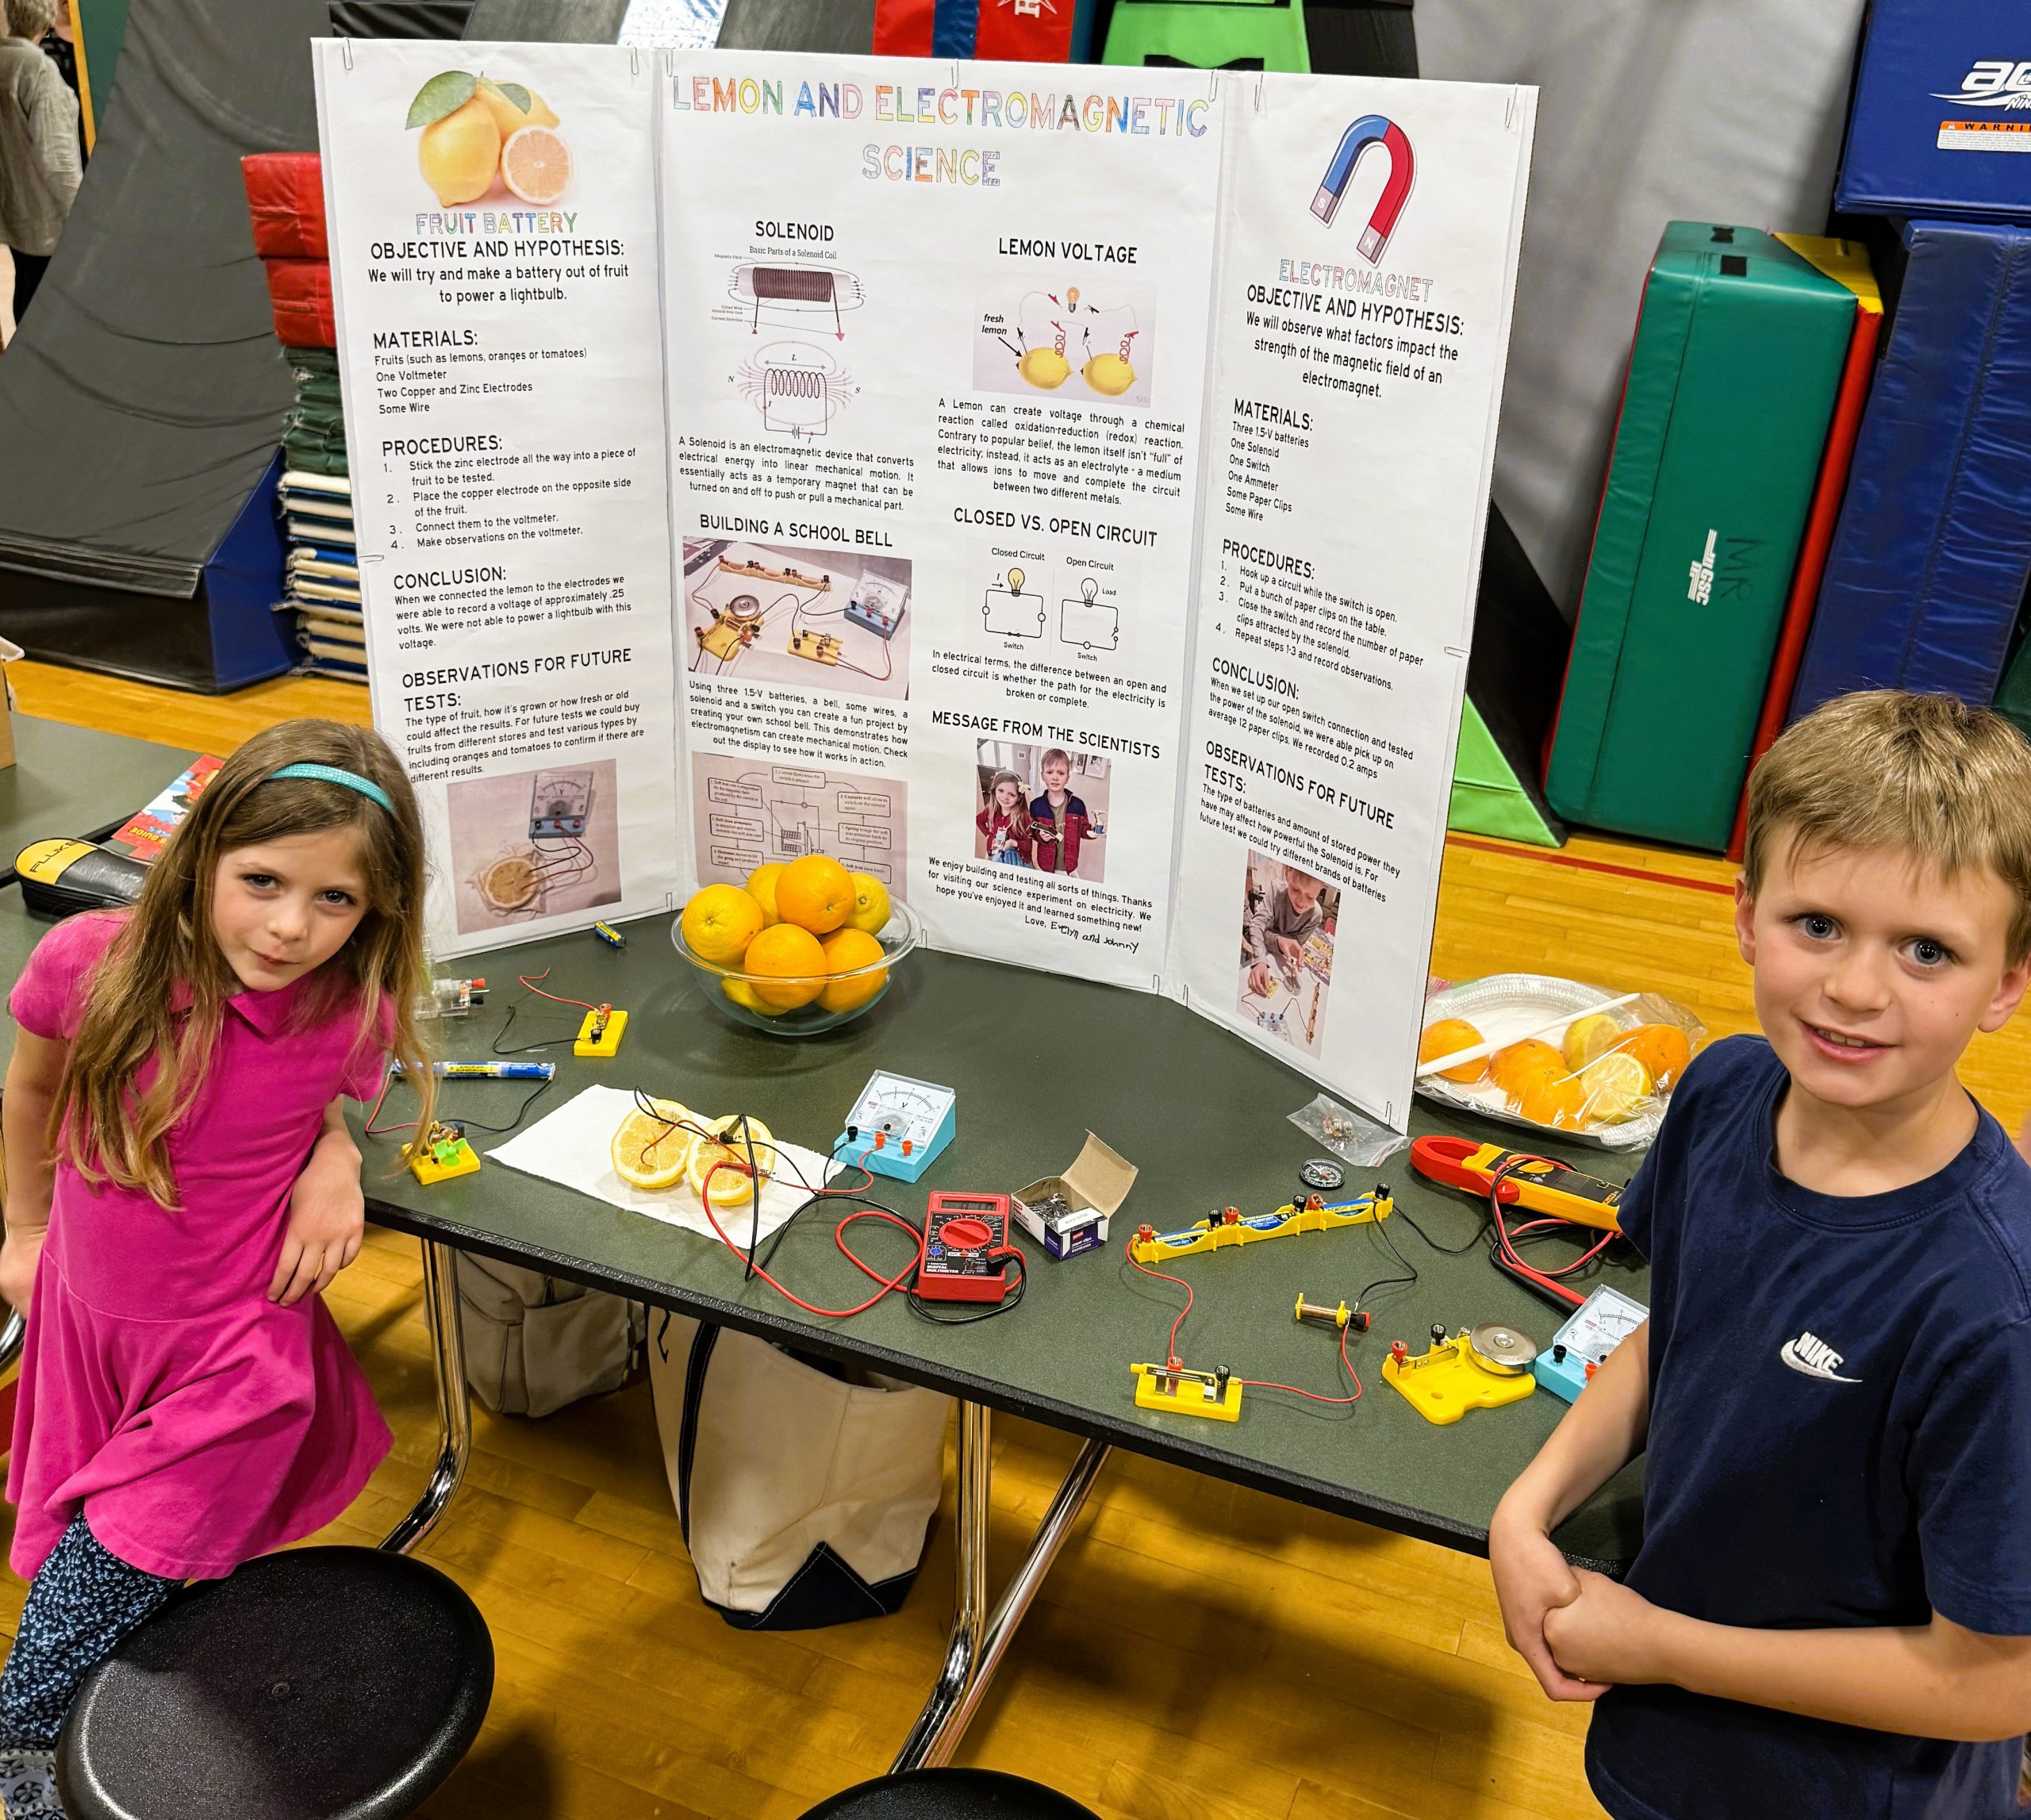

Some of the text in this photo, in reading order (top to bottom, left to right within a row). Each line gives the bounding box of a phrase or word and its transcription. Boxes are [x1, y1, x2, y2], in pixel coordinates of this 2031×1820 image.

[674, 75, 1209, 137] LEMON AND ELECTROMAGNETIC
[862, 144, 1000, 186] SCIENCE
[417, 213, 577, 234] FRUIT BATTERY
[755, 221, 834, 241] SOLENOID
[370, 240, 624, 259] OBJECTIVE AND HYPOTHESIS:
[767, 247, 783, 255] Parts
[797, 249, 824, 258] Solenoid
[999, 237, 1137, 264] LEMON VOLTAGE
[368, 264, 628, 285] We will try and make a battery out of fruit
[1279, 259, 1433, 302] ELECTROMAGNET
[440, 287, 566, 305] to power a lightbulb.
[984, 313, 1004, 323] fresh
[1247, 284, 1464, 336] OBJECTIVE AND HYPOTHESIS:
[374, 329, 478, 349] MATERIALS:
[981, 324, 1007, 335] lemon
[1247, 311, 1458, 360] We will observe what factors impact the
[374, 355, 404, 366] Fruits
[407, 354, 432, 365] (such
[450, 353, 486, 362] lemons,
[489, 352, 526, 363] oranges
[541, 348, 586, 359] tomatoes)
[1254, 338, 1442, 384] strength of the magnetic field of an
[376, 370, 447, 382] One Voltmeter
[1303, 371, 1381, 397] electromagnet.
[377, 382, 533, 399] Two Copper and Zinc Electrodes
[379, 402, 430, 414] Some Wire
[939, 397, 946, 408] A
[953, 399, 983, 411] Lemon
[1013, 407, 1042, 417] create
[1050, 409, 1082, 423] voltage
[1090, 413, 1124, 428] through
[1145, 420, 1184, 432] chemical
[1234, 398, 1313, 432] MATERIALS:
[1233, 420, 1308, 447] Three 1.5-V batteries
[382, 435, 502, 456] PROCEDURES:
[1231, 438, 1280, 458] One Solenoid
[1230, 454, 1269, 473] One Switch
[1228, 470, 1278, 491] One Ammeter
[1227, 486, 1292, 513] Some Paper Clips
[1226, 502, 1263, 521] Some Wire
[701, 514, 893, 547] BUILDING A SCHOOL BELL
[954, 507, 1158, 547] CLOSED VS. OPEN CIRCUIT
[992, 547, 1045, 561] Closed Circuit
[1066, 556, 1114, 571] Open Circuit
[1223, 539, 1315, 580] PROCEDURES:
[394, 566, 506, 589] CONCLUSION:
[402, 648, 632, 688] OBSERVATIONS FOR FUTURE
[1077, 652, 1097, 662] Switch
[1212, 657, 1299, 700] CONCLUSION:
[404, 693, 461, 712] TESTS:
[932, 710, 1160, 758] MESSAGE FROM THE SCIENTISTS
[1204, 764, 1246, 793] TESTS:
[1206, 740, 1394, 829] OBSERVATIONS FOR FUTURE
[129, 827, 159, 842] GUIDE
[29, 841, 78, 873] FLUKE
[1025, 916, 1046, 928] Love,
[1082, 934, 1100, 943] and
[1794, 1331, 1844, 1374] NIKE
